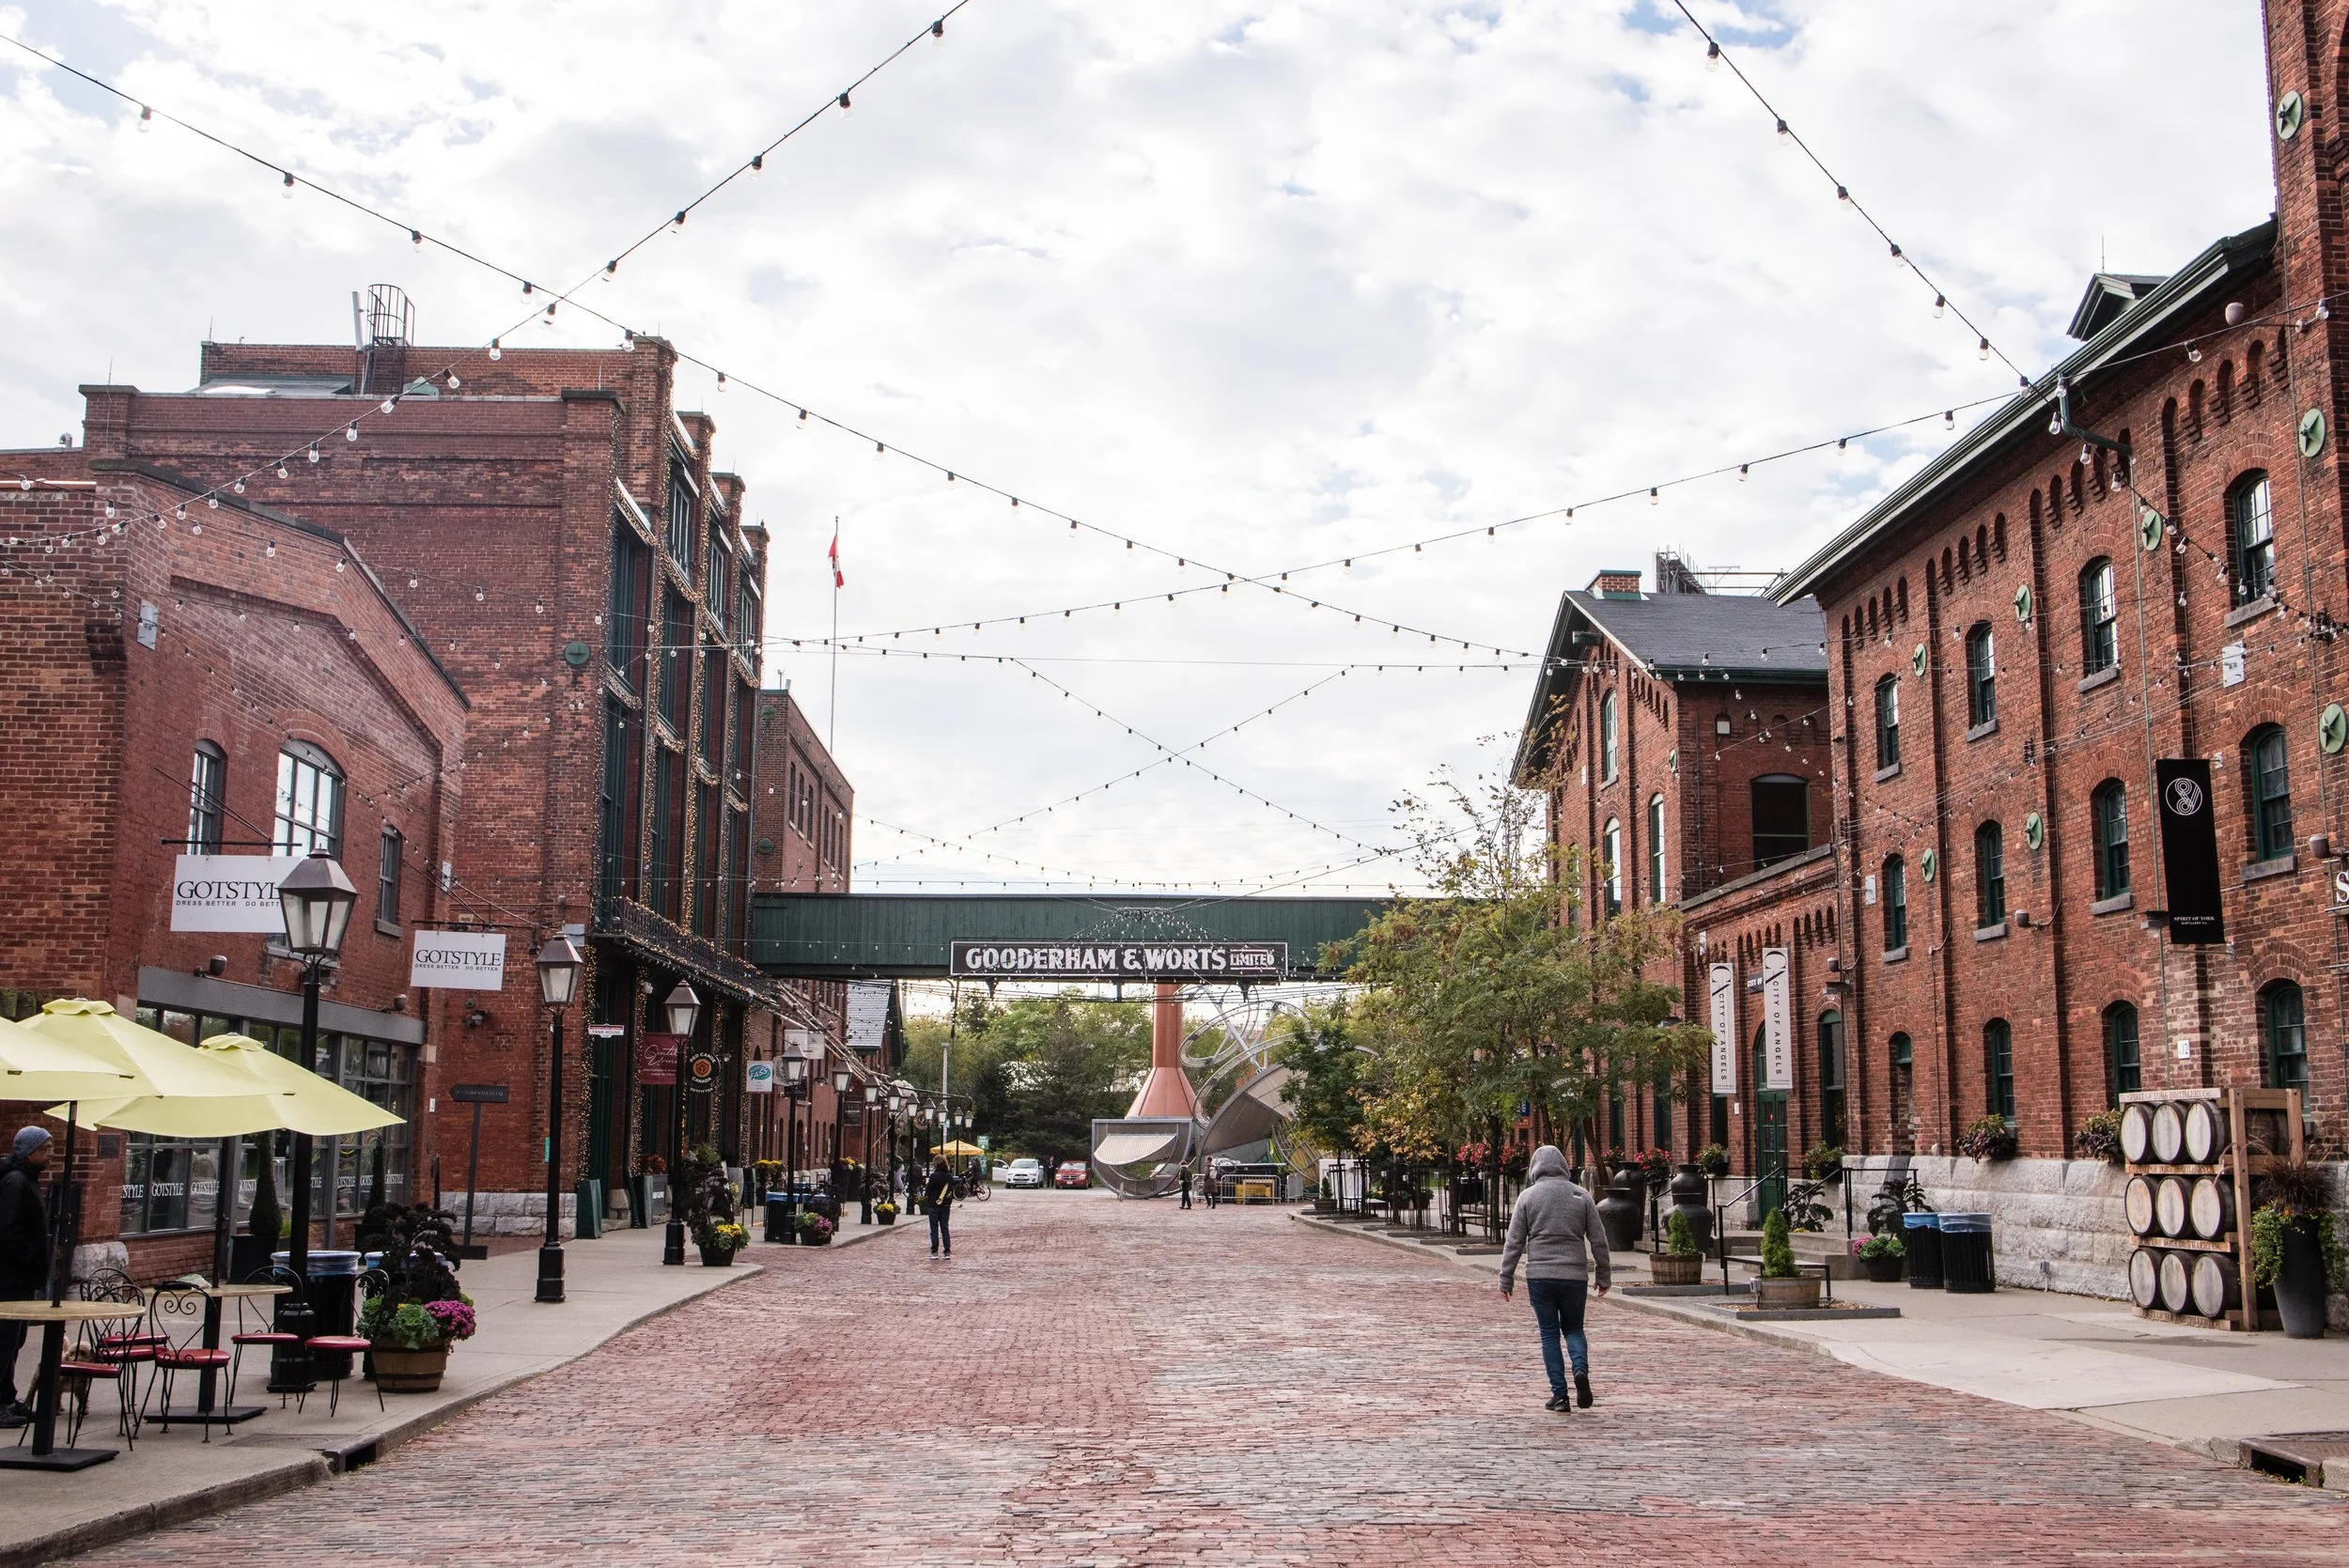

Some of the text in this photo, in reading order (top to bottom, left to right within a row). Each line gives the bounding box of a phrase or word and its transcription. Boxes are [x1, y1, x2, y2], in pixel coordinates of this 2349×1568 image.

[177, 880, 281, 899] GOTSTYL
[415, 949, 501, 967] GOTSTYLE
[966, 948, 1274, 970] GOODERHAM & WORTS LIMITED
[1774, 1012, 1780, 1025] OF
[1719, 1022, 1725, 1033] OF
[690, 1052, 716, 1063] RED CANOE
[120, 1184, 144, 1199] STYLE
[151, 1182, 184, 1197] GOTSTYLE
